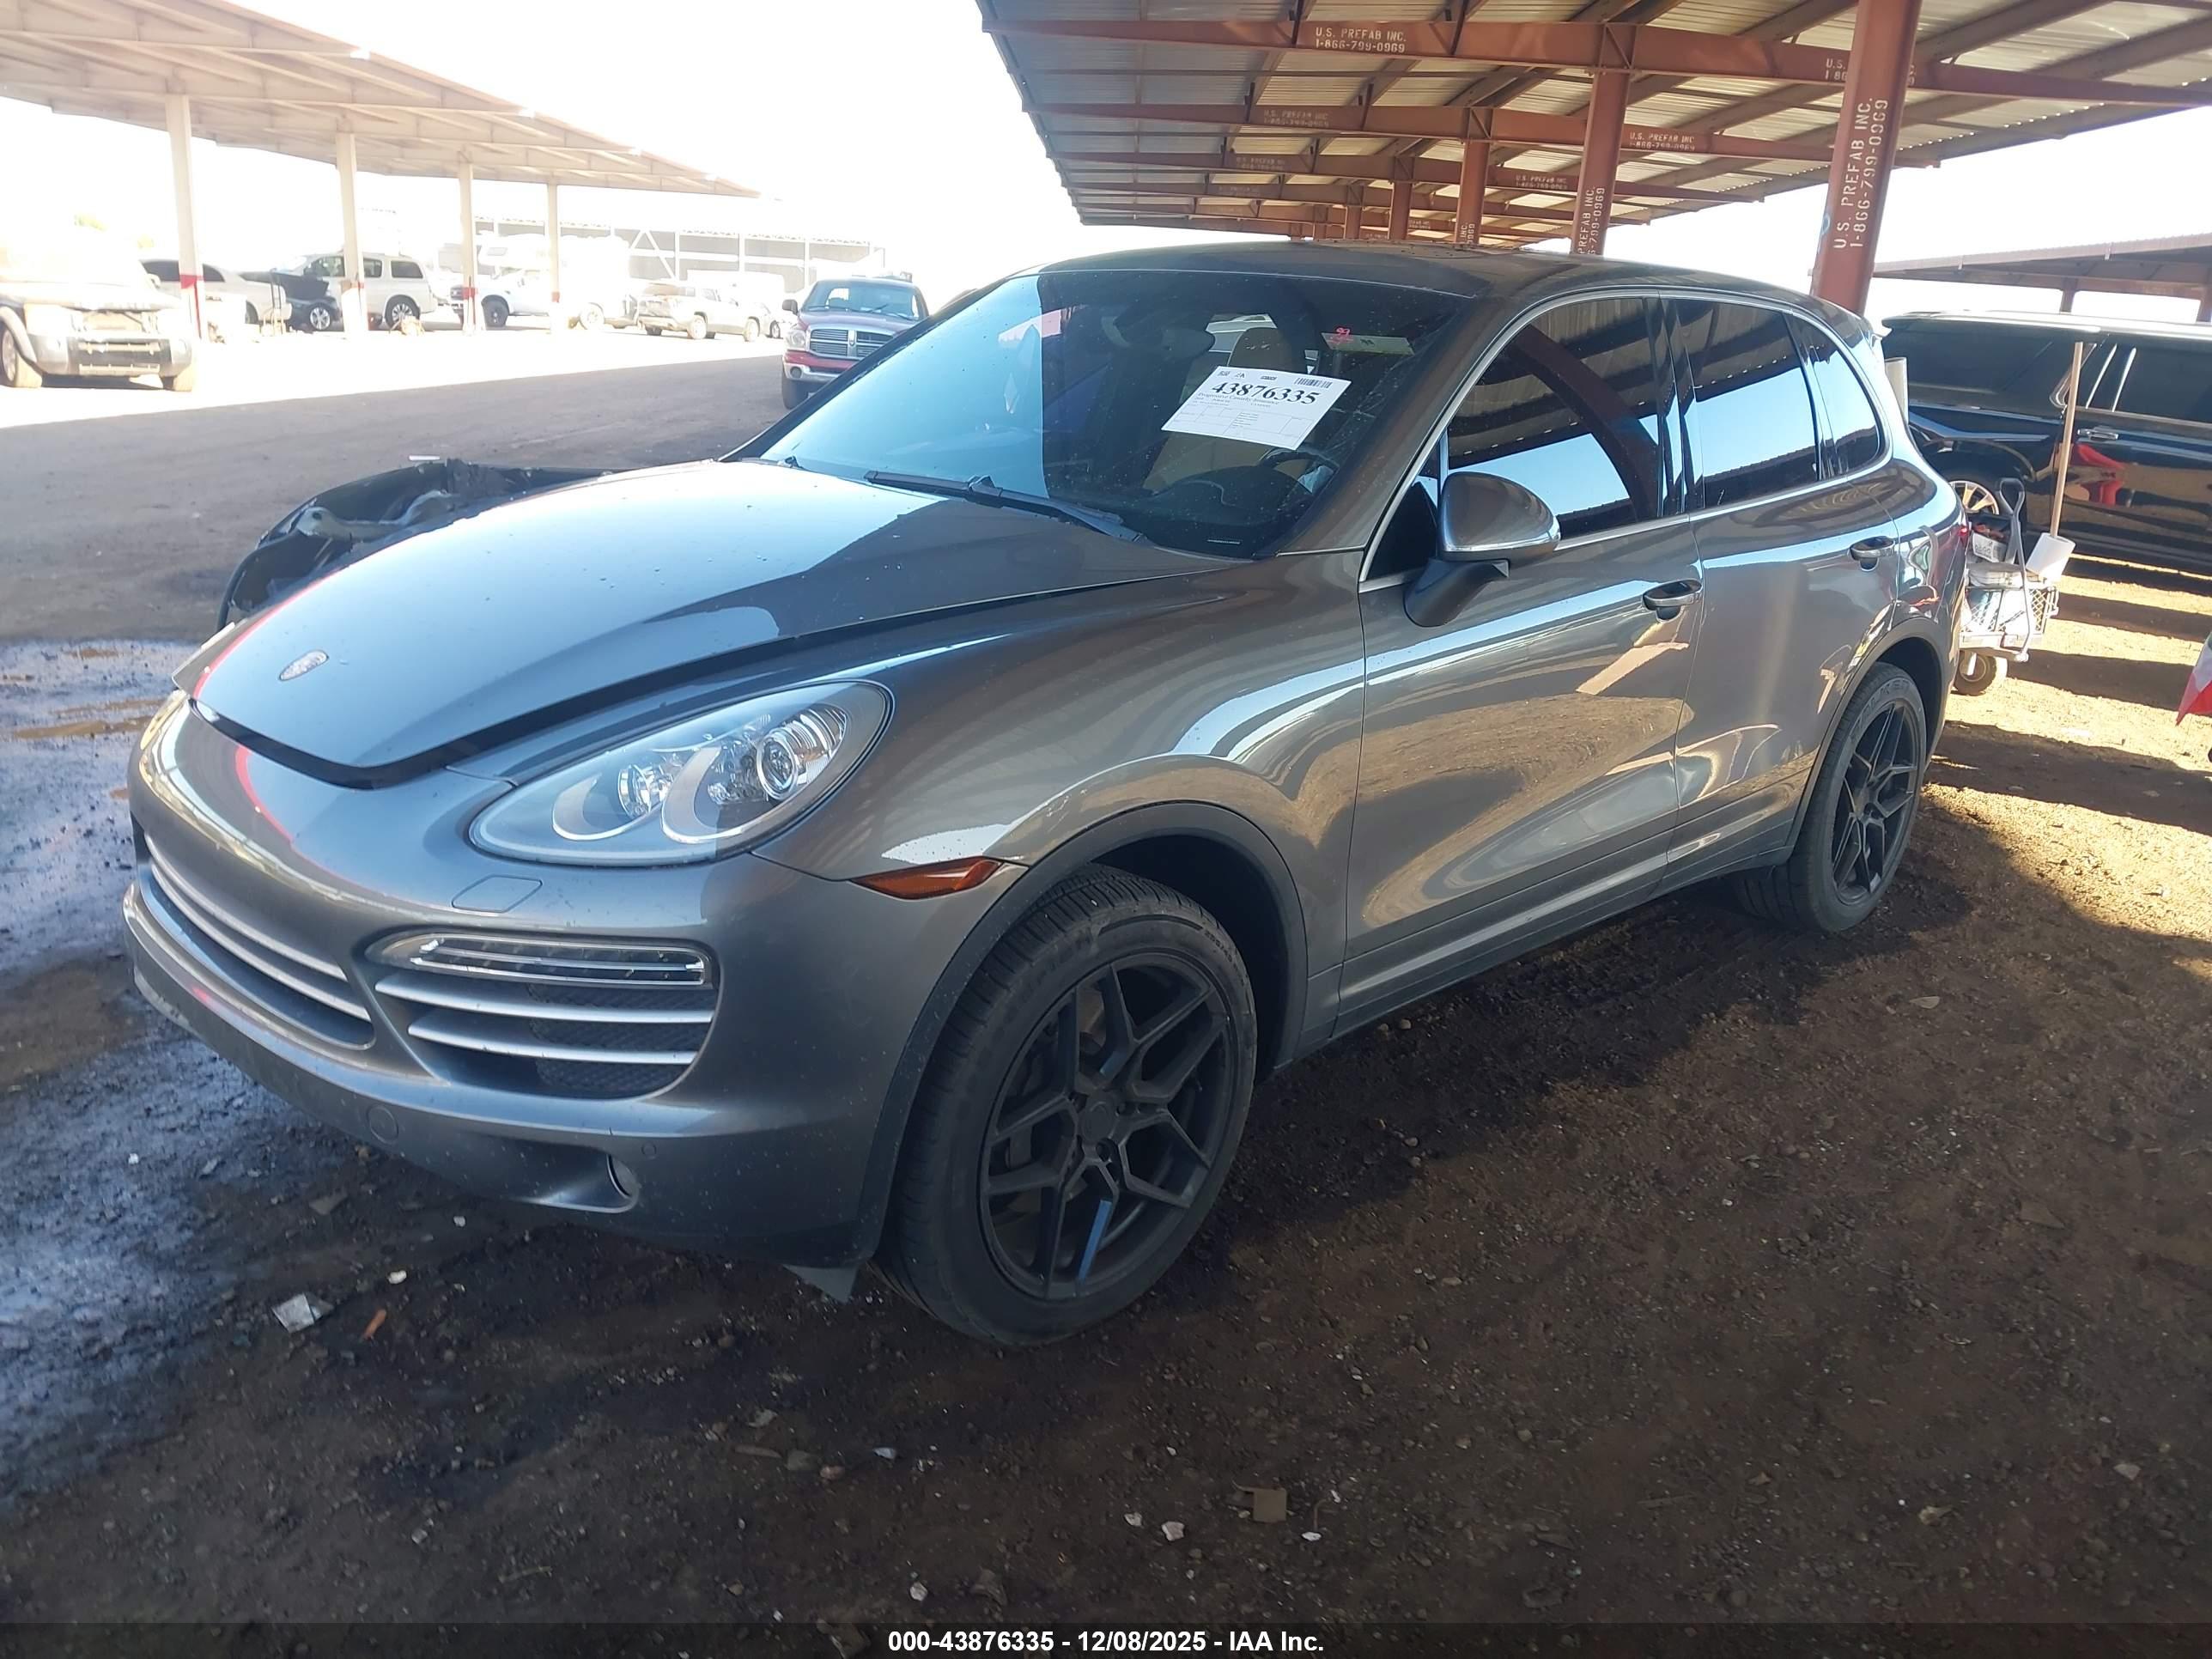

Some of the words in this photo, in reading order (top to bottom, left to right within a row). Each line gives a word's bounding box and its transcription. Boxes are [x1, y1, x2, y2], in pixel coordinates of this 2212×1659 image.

[1316, 27, 1335, 38] U.S.
[1340, 28, 1382, 40] PREFAB
[1386, 31, 1407, 42] INC.
[1316, 39, 1406, 53] 1-866-799-0969
[1826, 58, 1846, 70] U.S.
[1854, 97, 1874, 130] INC.
[1649, 133, 1679, 143] PREFAB
[1840, 139, 1864, 206] PREFAB
[1850, 99, 1888, 248] 1-866-799-0969
[1577, 212, 1591, 254] PREFAB
[1833, 216, 1851, 248] U.S.
[1212, 381, 1322, 404] 43876335
